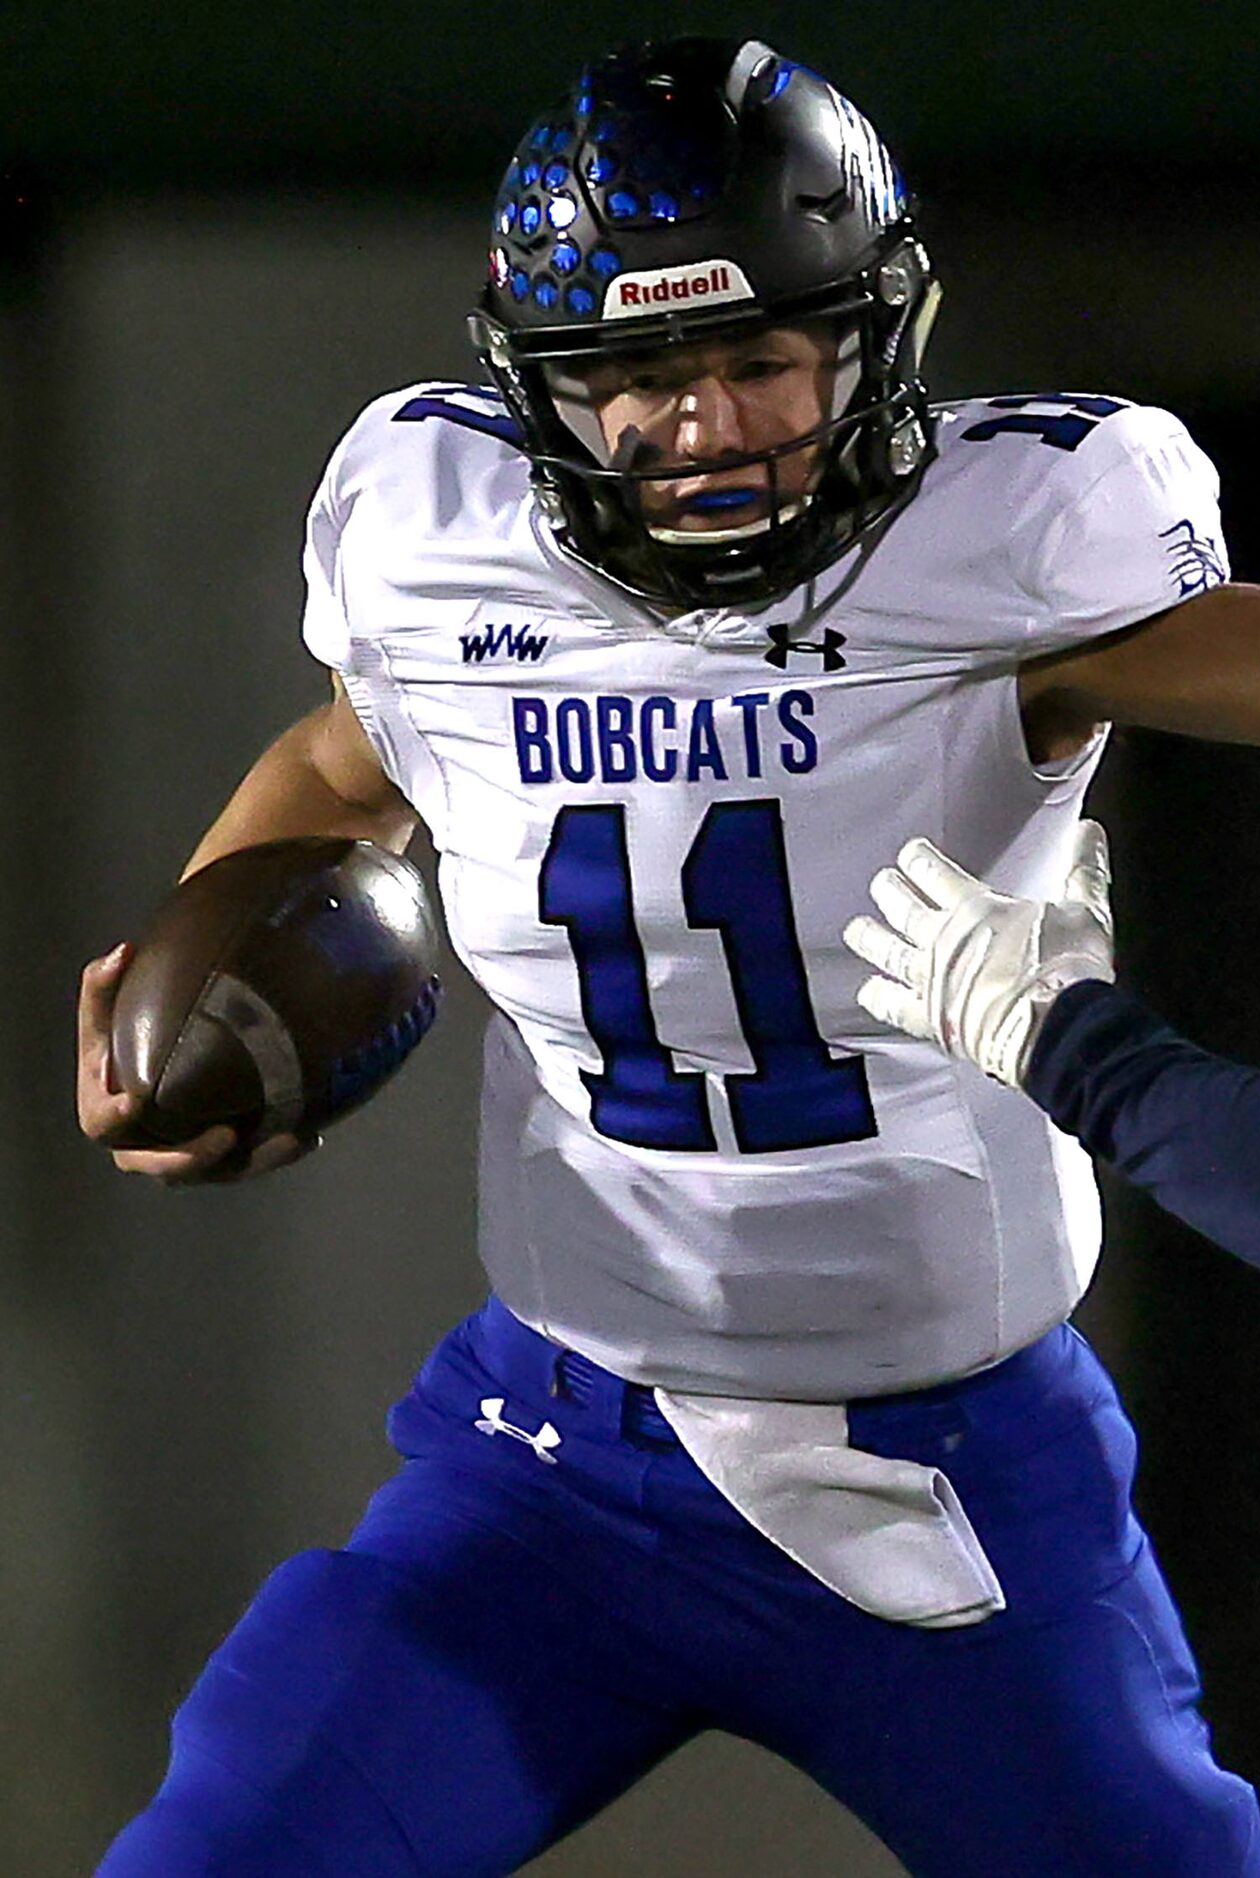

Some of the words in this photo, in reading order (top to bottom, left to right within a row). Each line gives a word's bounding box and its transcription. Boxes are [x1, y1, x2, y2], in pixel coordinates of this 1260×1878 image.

[619, 267, 730, 306] Riddell
[960, 392, 1131, 452] 11
[512, 689, 818, 784] BOBCATS
[538, 797, 880, 1155] 11
